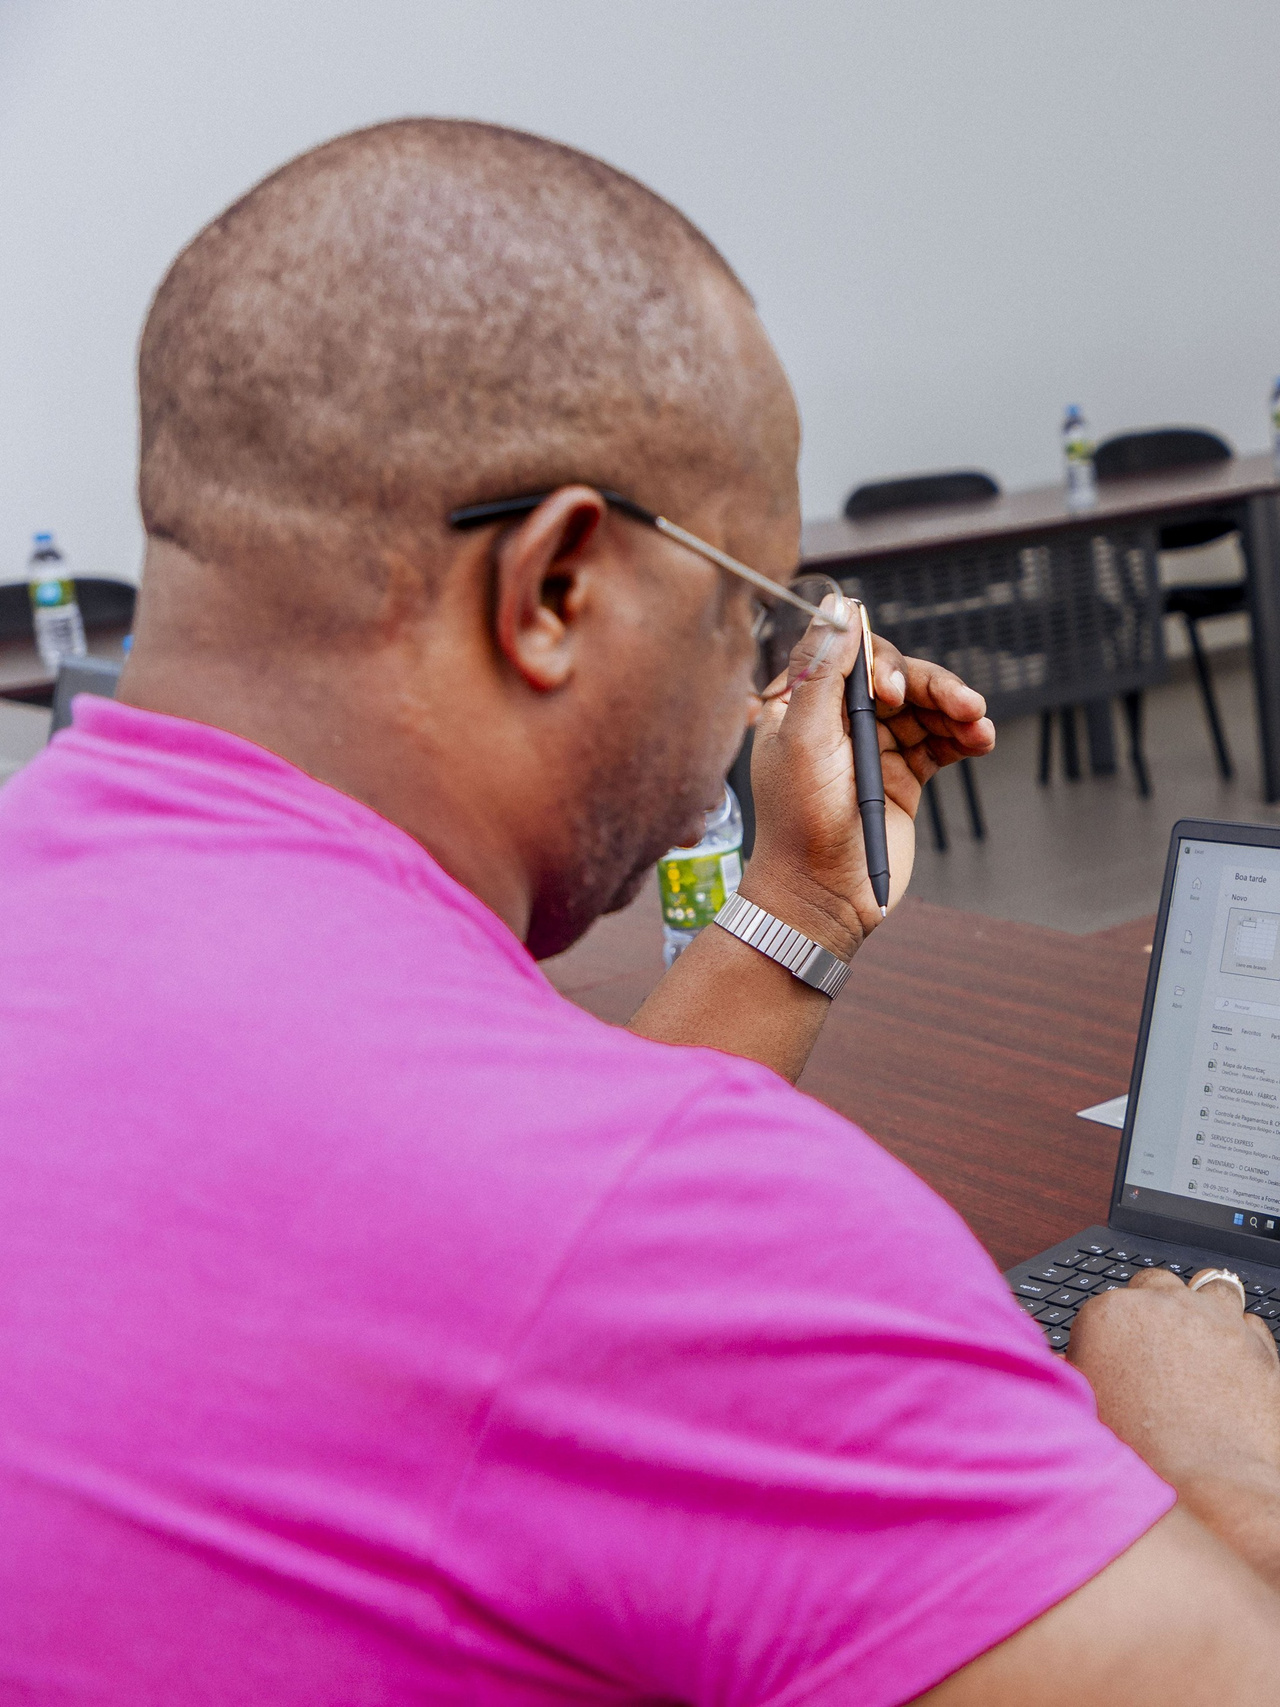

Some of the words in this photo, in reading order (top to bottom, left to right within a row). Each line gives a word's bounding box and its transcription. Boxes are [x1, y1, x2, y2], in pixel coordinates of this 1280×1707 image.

[1234, 872, 1247, 881] Boa
[1248, 874, 1267, 883] tarde
[1231, 893, 1247, 902] Novo
[1211, 1023, 1233, 1032] Recentes
[1240, 1028, 1261, 1036] Favoritos
[1218, 1085, 1253, 1096] CRONOGRAMA
[1257, 1091, 1277, 1101] FÁBRICA
[1214, 1109, 1234, 1118] Controle
[1240, 1114, 1269, 1126] Pagamentos
[1210, 1133, 1233, 1144] SERVIÇOS
[1233, 1138, 1254, 1148] EXPRESS
[1206, 1157, 1235, 1169] INVENTÁRIO
[1243, 1165, 1269, 1176] CANTINHO
[1232, 1188, 1260, 1201] Pagamentos
